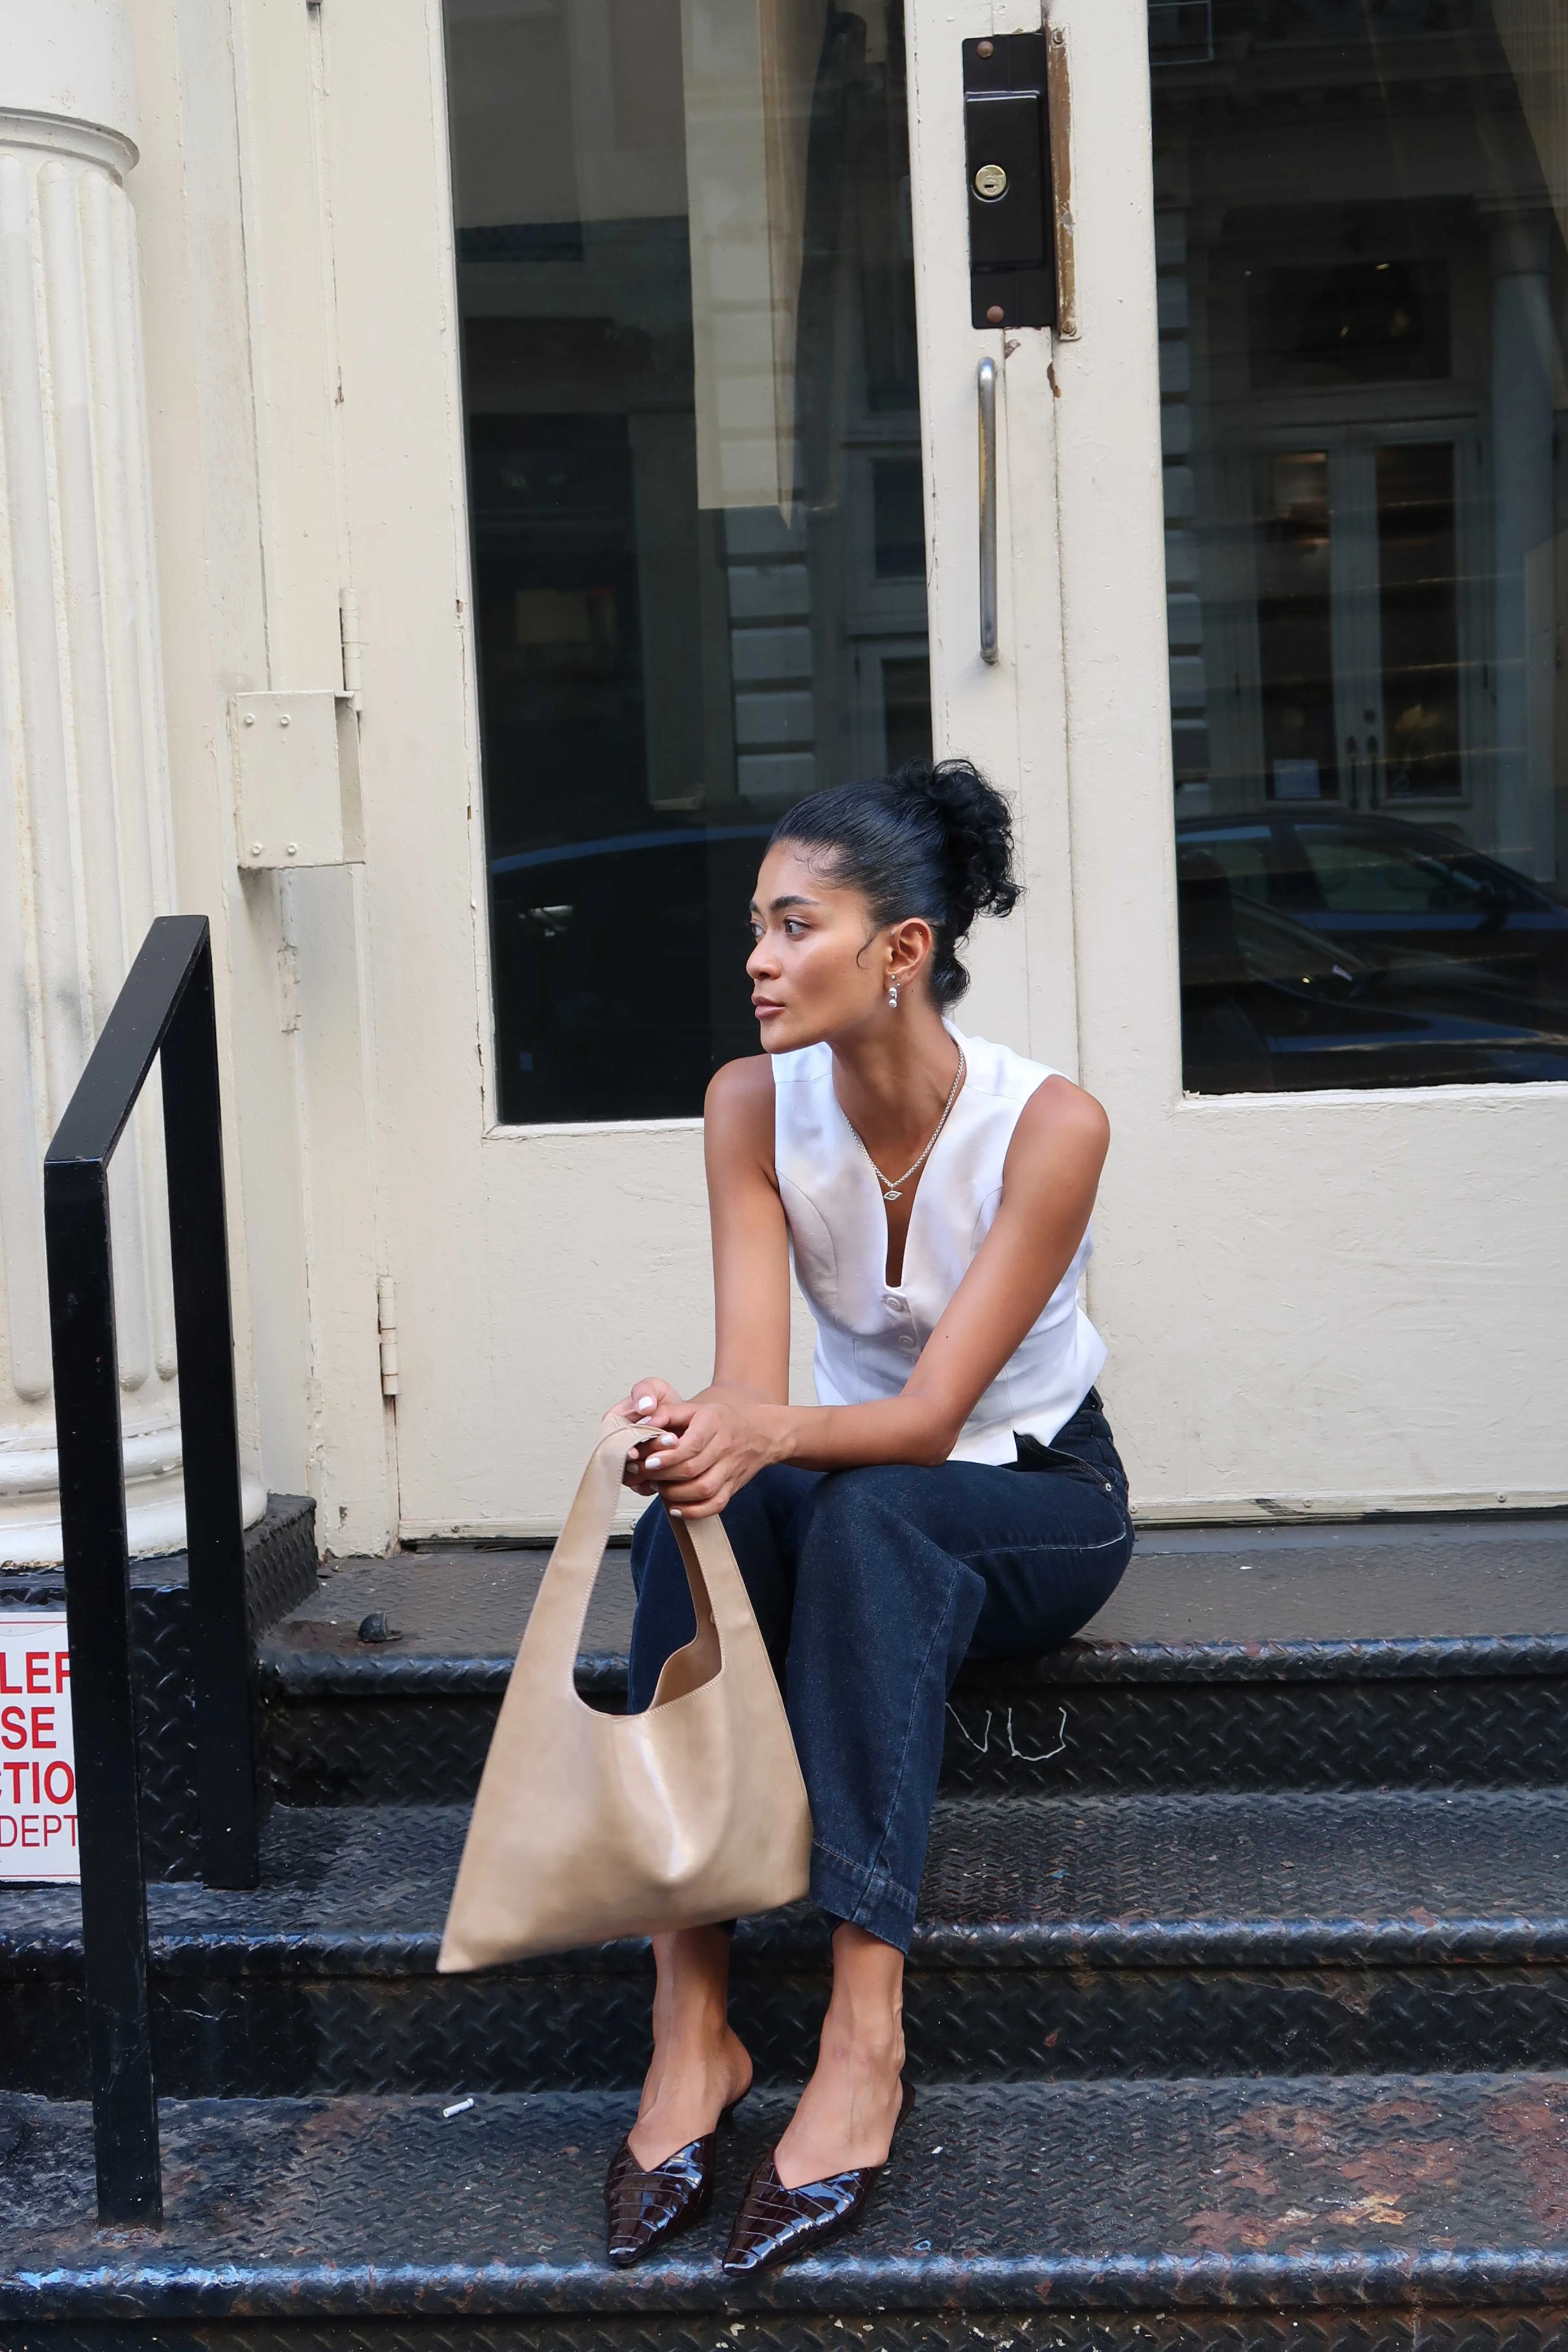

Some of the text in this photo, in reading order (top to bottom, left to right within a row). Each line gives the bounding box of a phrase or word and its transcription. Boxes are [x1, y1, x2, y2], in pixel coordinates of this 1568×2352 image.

[1, 1706, 56, 1750] SE
[0, 1761, 74, 1805] TIO
[0, 1815, 78, 1847] DEPT
